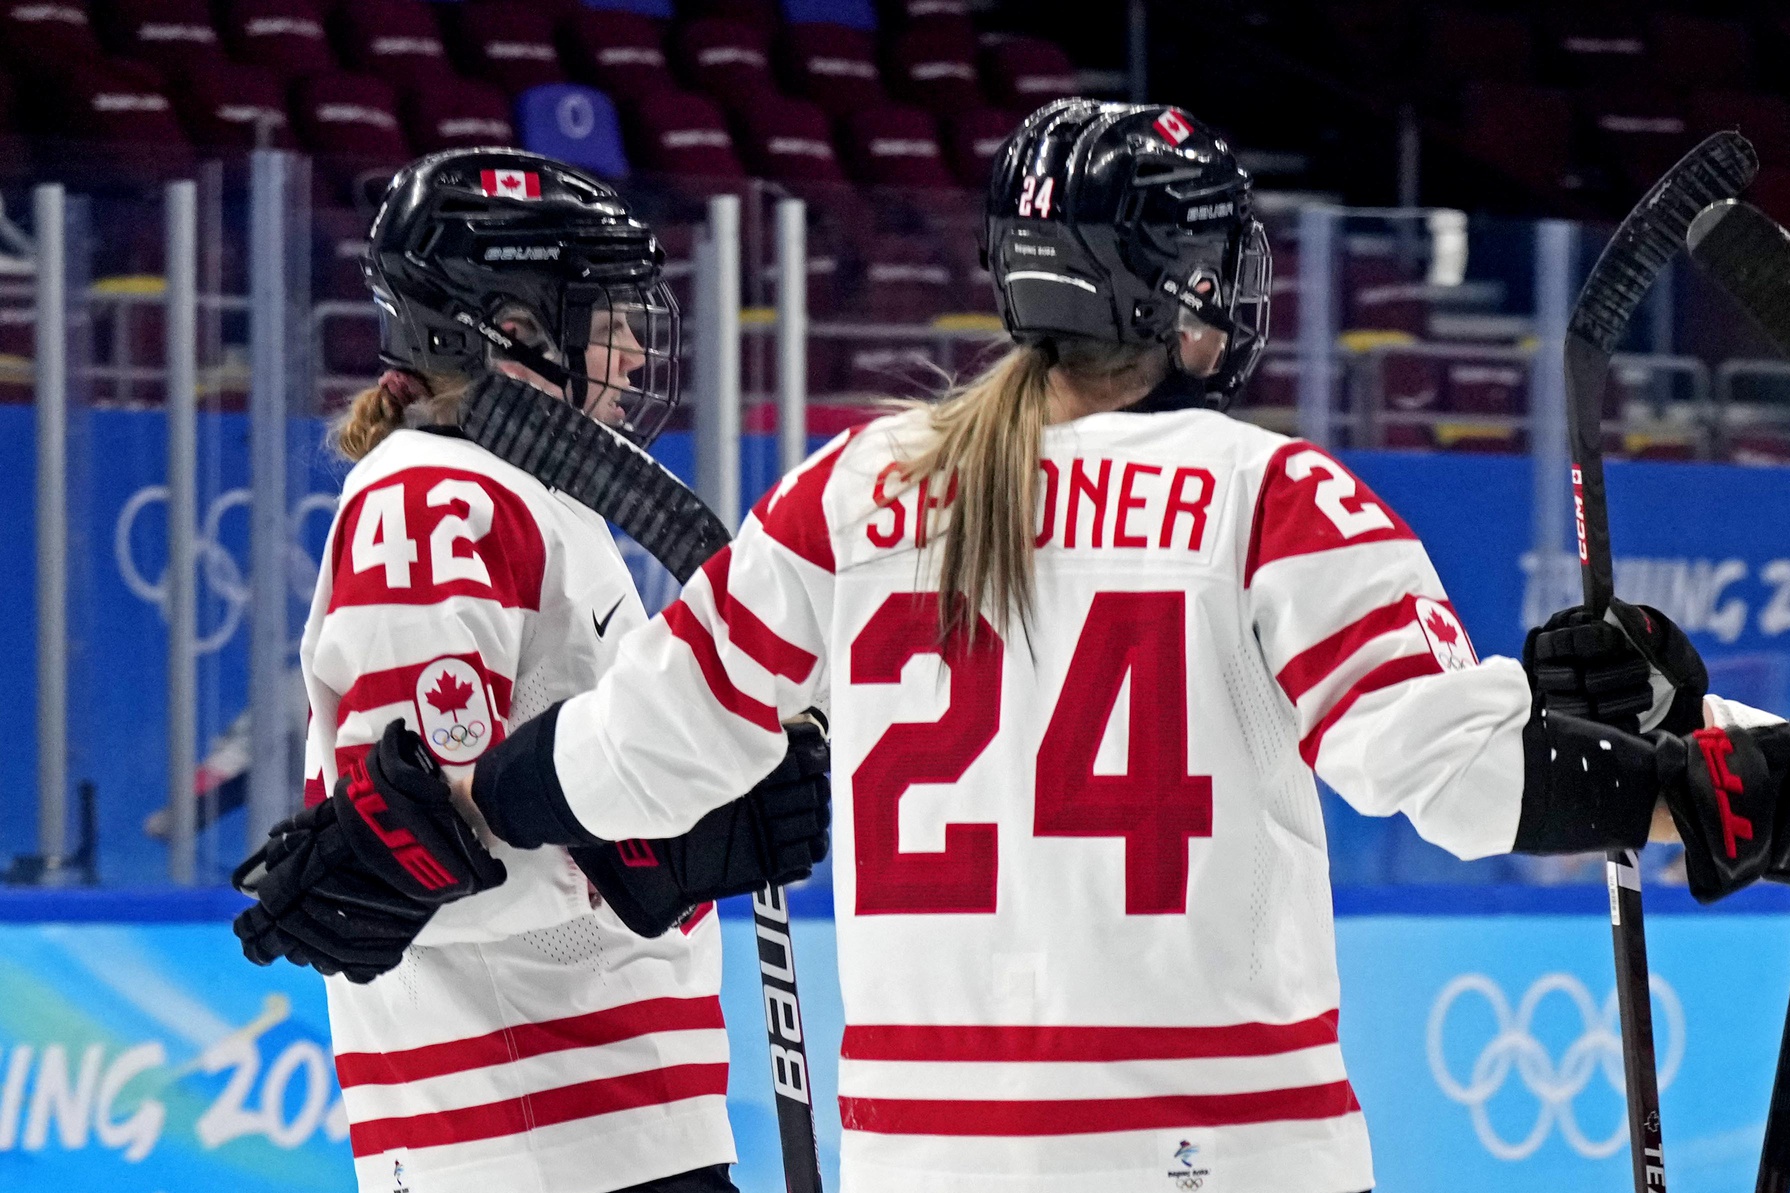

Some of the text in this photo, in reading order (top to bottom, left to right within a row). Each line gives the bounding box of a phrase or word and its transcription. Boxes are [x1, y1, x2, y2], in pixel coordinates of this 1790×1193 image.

[1018, 176, 1054, 218] 24
[351, 477, 495, 589] 42
[866, 458, 1216, 552] SPONER
[1574, 494, 1588, 561] CCM
[849, 590, 1213, 917] 24
